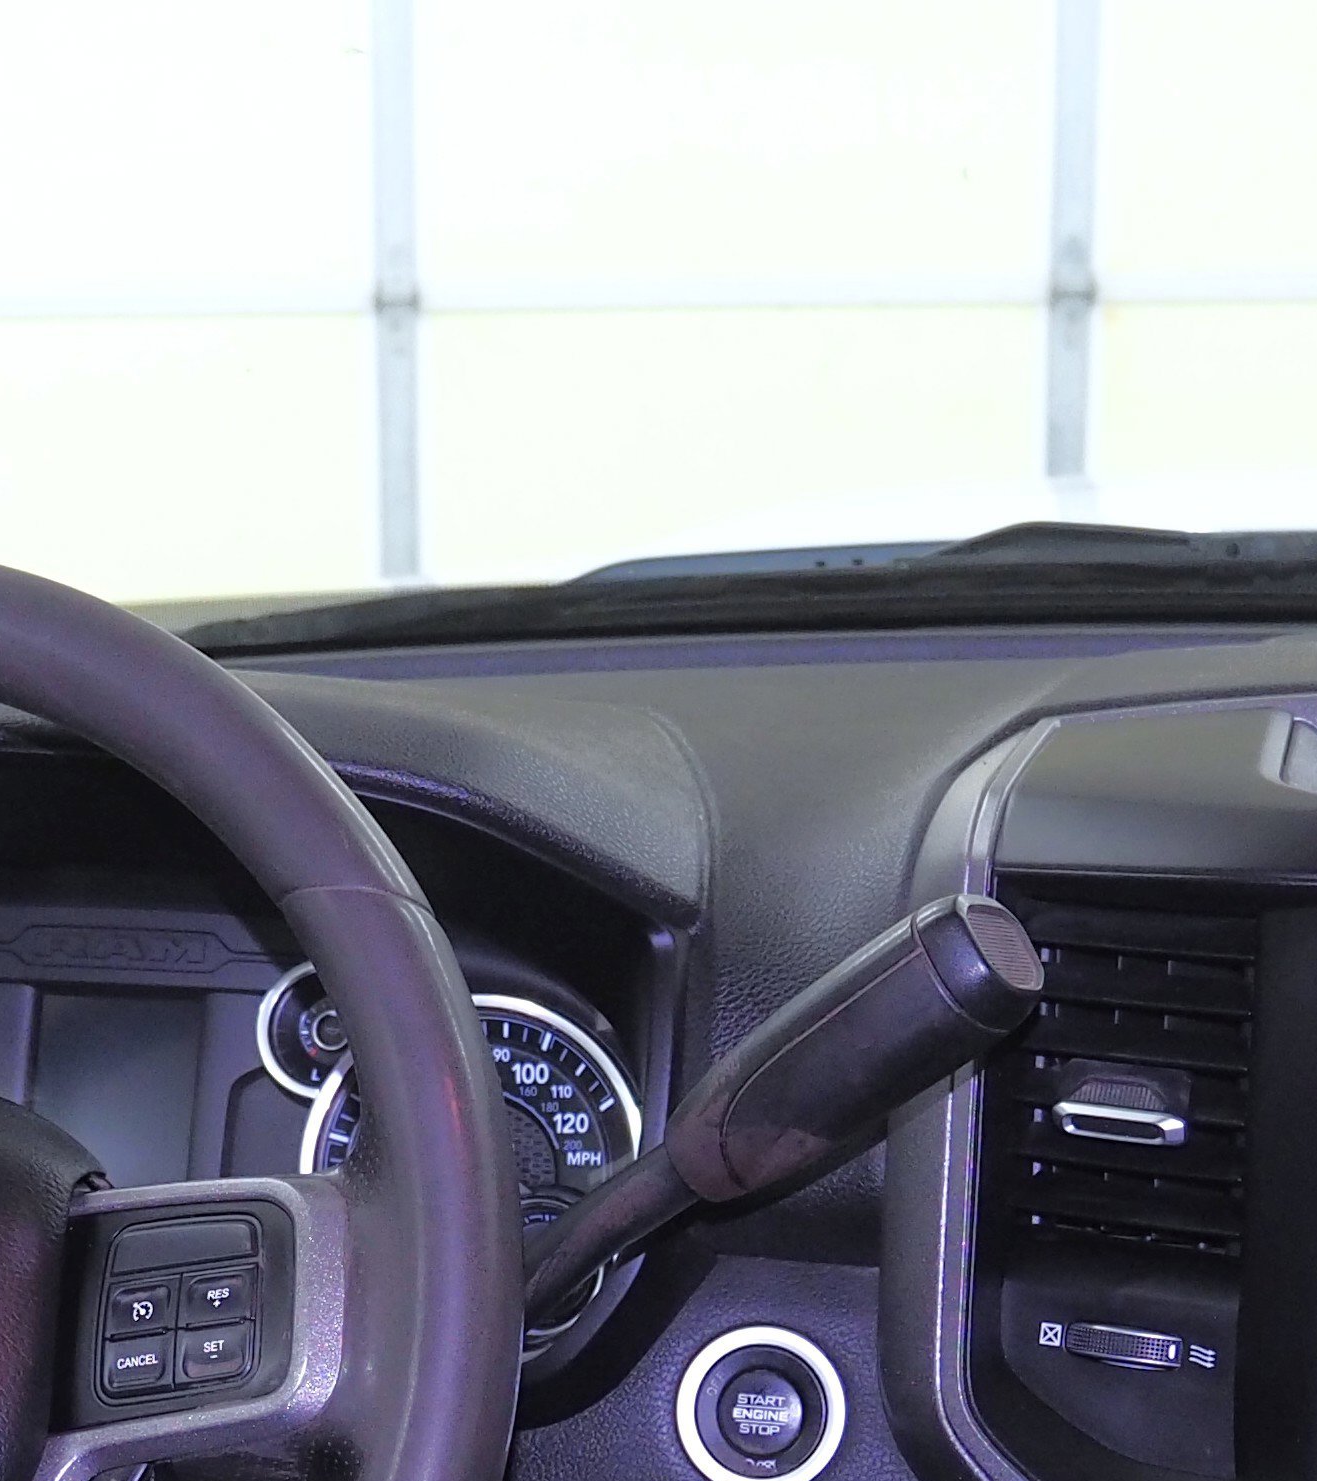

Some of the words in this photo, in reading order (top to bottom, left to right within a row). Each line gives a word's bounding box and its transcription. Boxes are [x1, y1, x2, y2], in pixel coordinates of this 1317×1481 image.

[492, 1048, 511, 1062] 90
[511, 1063, 549, 1084] 100
[520, 1086, 538, 1096] 160
[550, 1085, 572, 1098] 110
[541, 1102, 559, 1112] 180
[553, 1113, 589, 1134] 120
[567, 1151, 601, 1166] MPH
[207, 1287, 230, 1300] RES
[203, 1340, 224, 1353] SET
[117, 1353, 159, 1370] CANCEL
[737, 1392, 786, 1407] START
[733, 1407, 790, 1422] ENGINE
[739, 1423, 781, 1436] STOP
